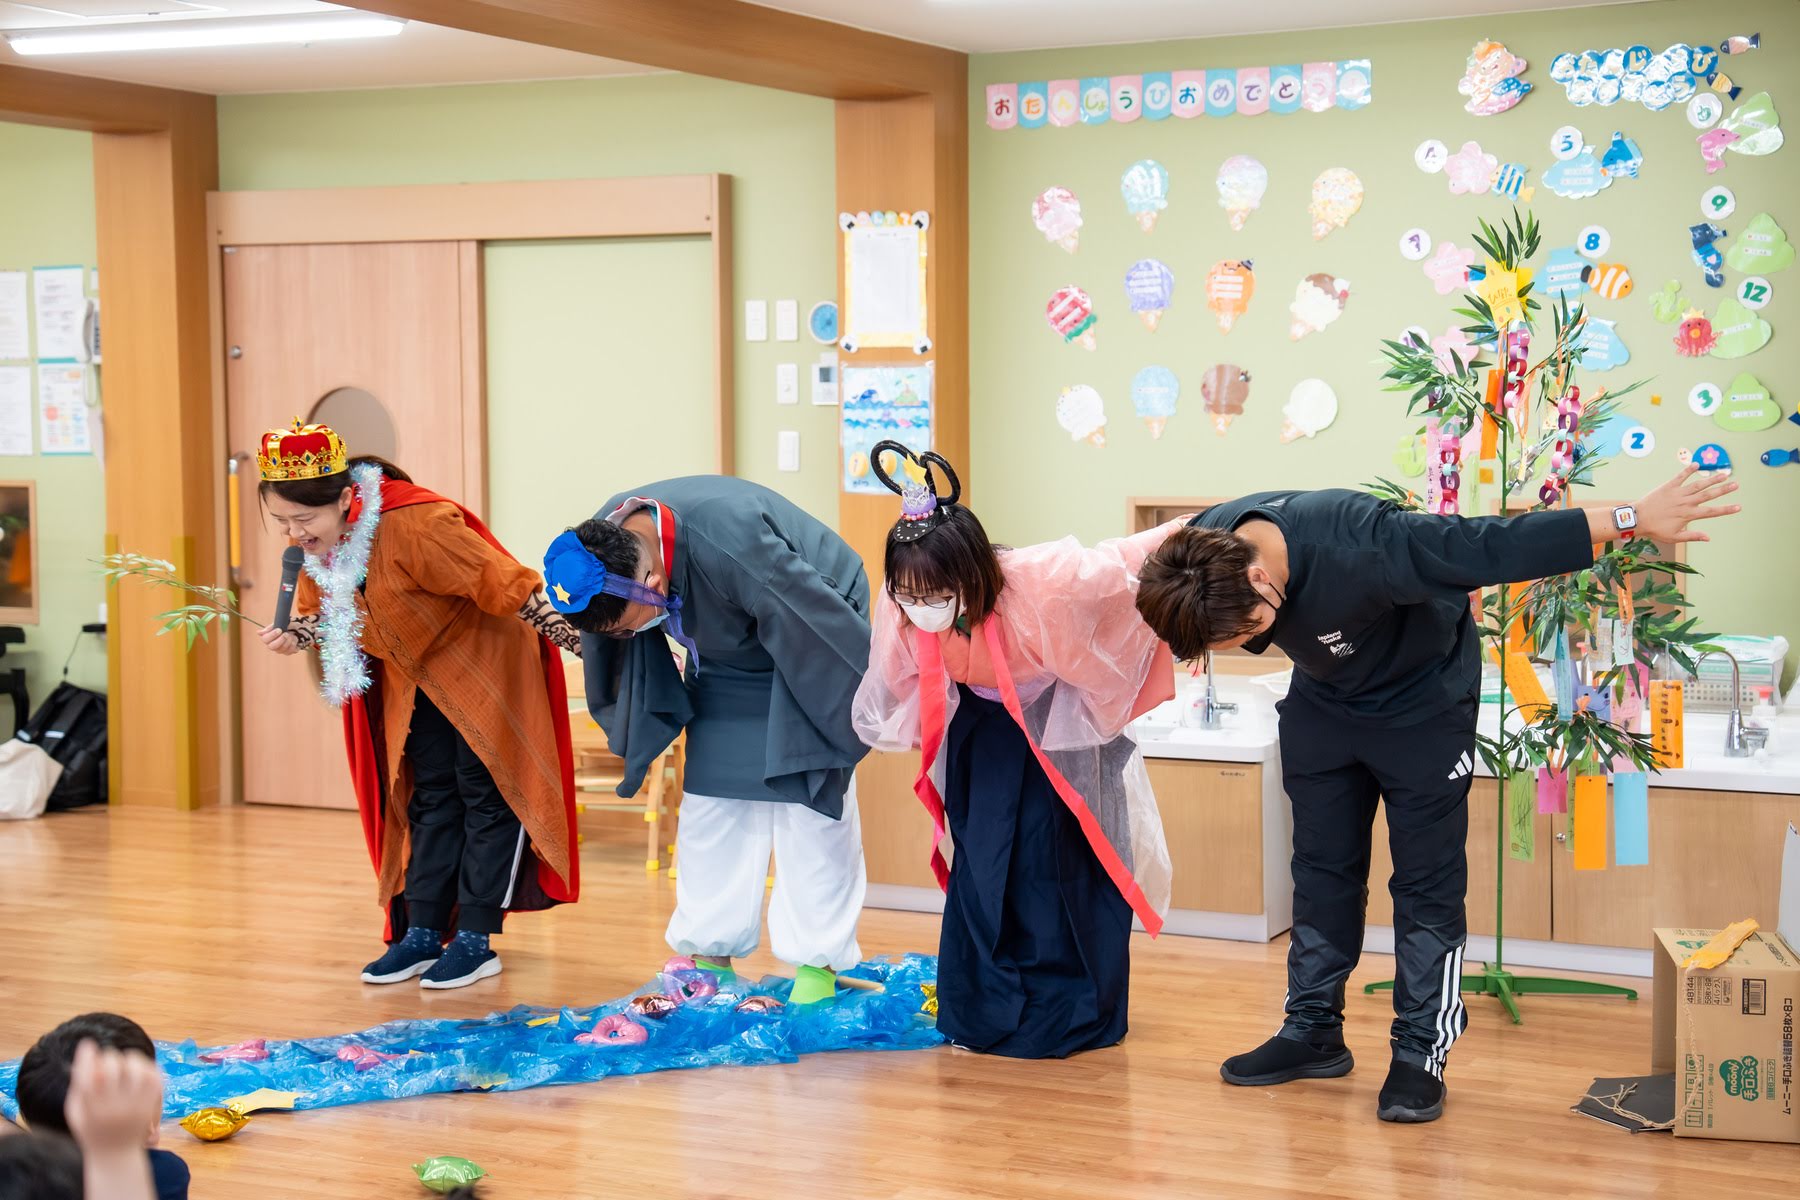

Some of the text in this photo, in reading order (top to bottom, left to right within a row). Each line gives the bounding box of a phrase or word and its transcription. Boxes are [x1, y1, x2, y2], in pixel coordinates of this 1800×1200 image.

[1561, 134, 1574, 152] 5
[1711, 194, 1728, 211] 9
[1584, 232, 1600, 252] 8
[1742, 281, 1768, 303] 12
[1697, 390, 1714, 408] 3
[1629, 431, 1645, 450] 2
[1742, 1057, 1757, 1100] 手口ふき
